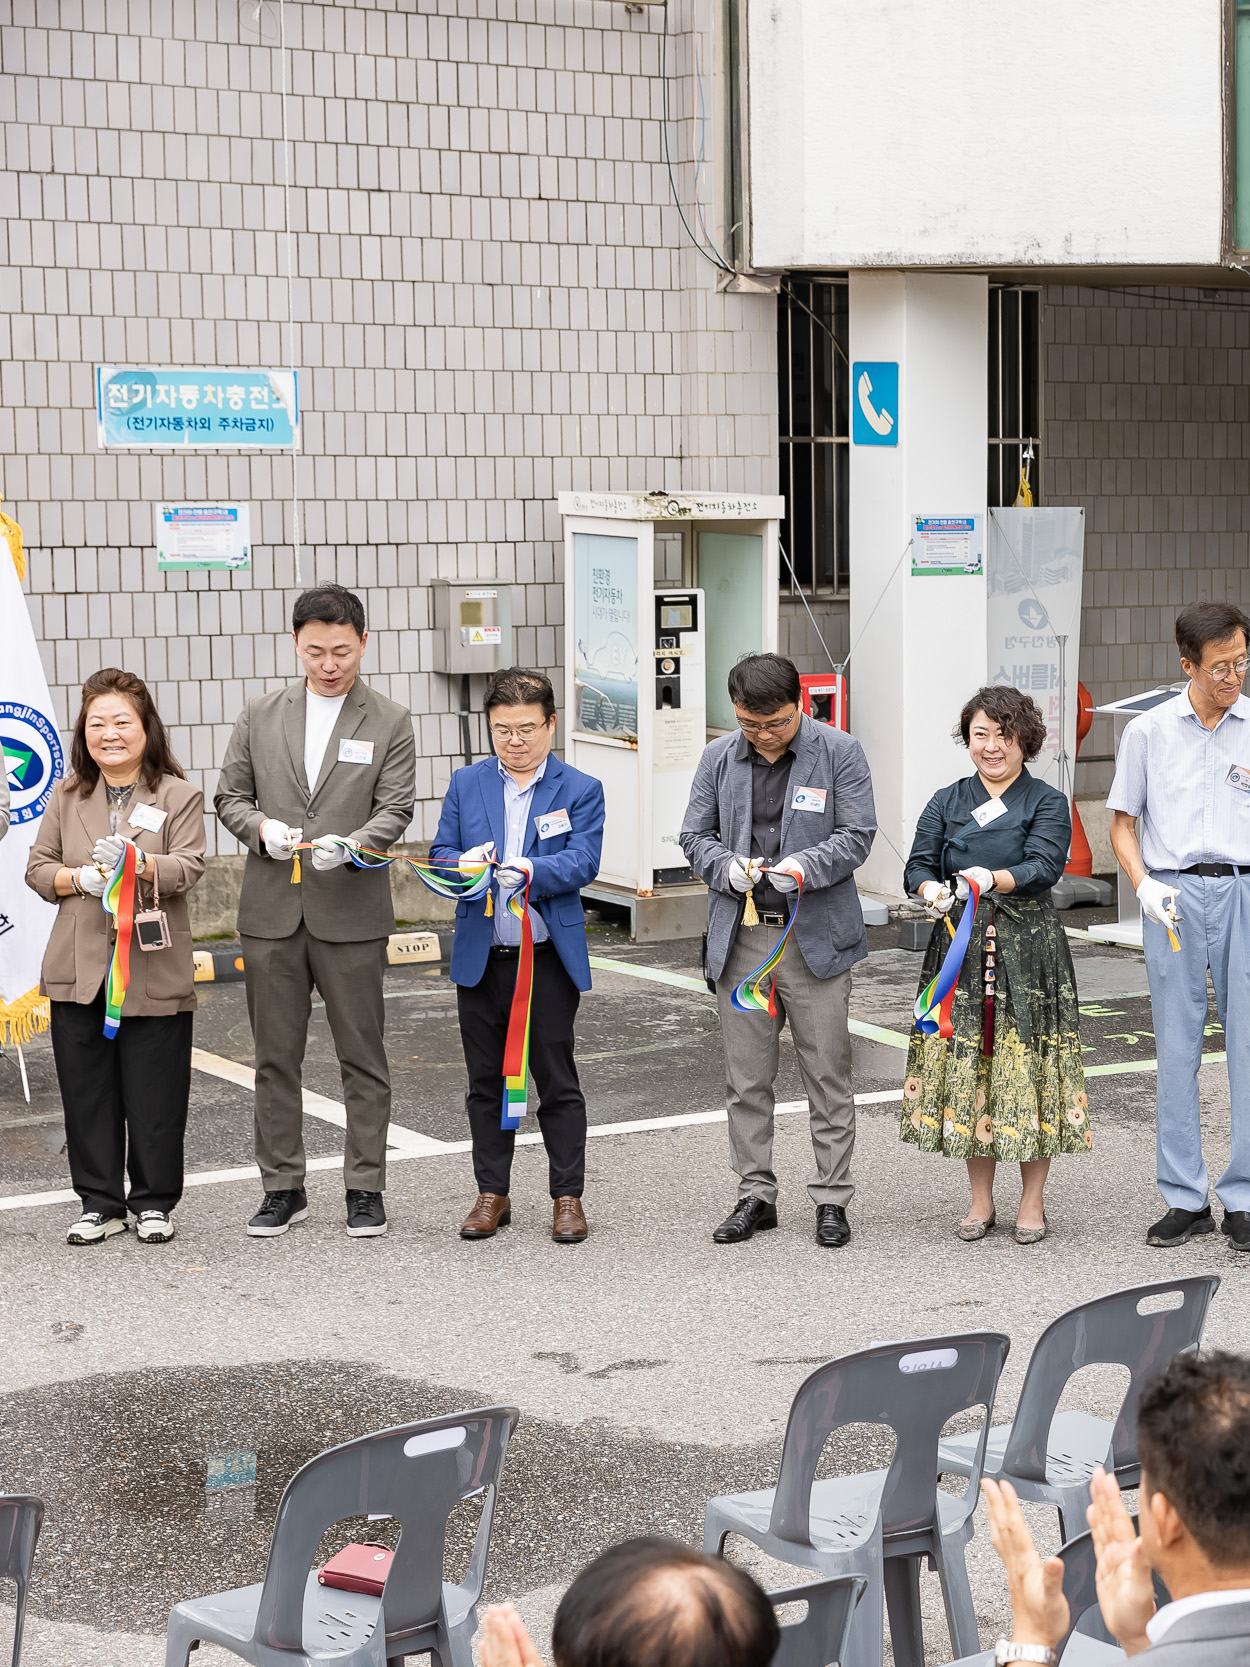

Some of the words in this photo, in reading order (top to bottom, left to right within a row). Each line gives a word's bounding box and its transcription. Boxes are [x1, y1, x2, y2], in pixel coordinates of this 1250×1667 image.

[126, 416, 211, 432] (전기자동차외
[218, 416, 275, 432] 주차금지)
[592, 586, 623, 605] 전기자동차
[397, 943, 429, 953] STOP
